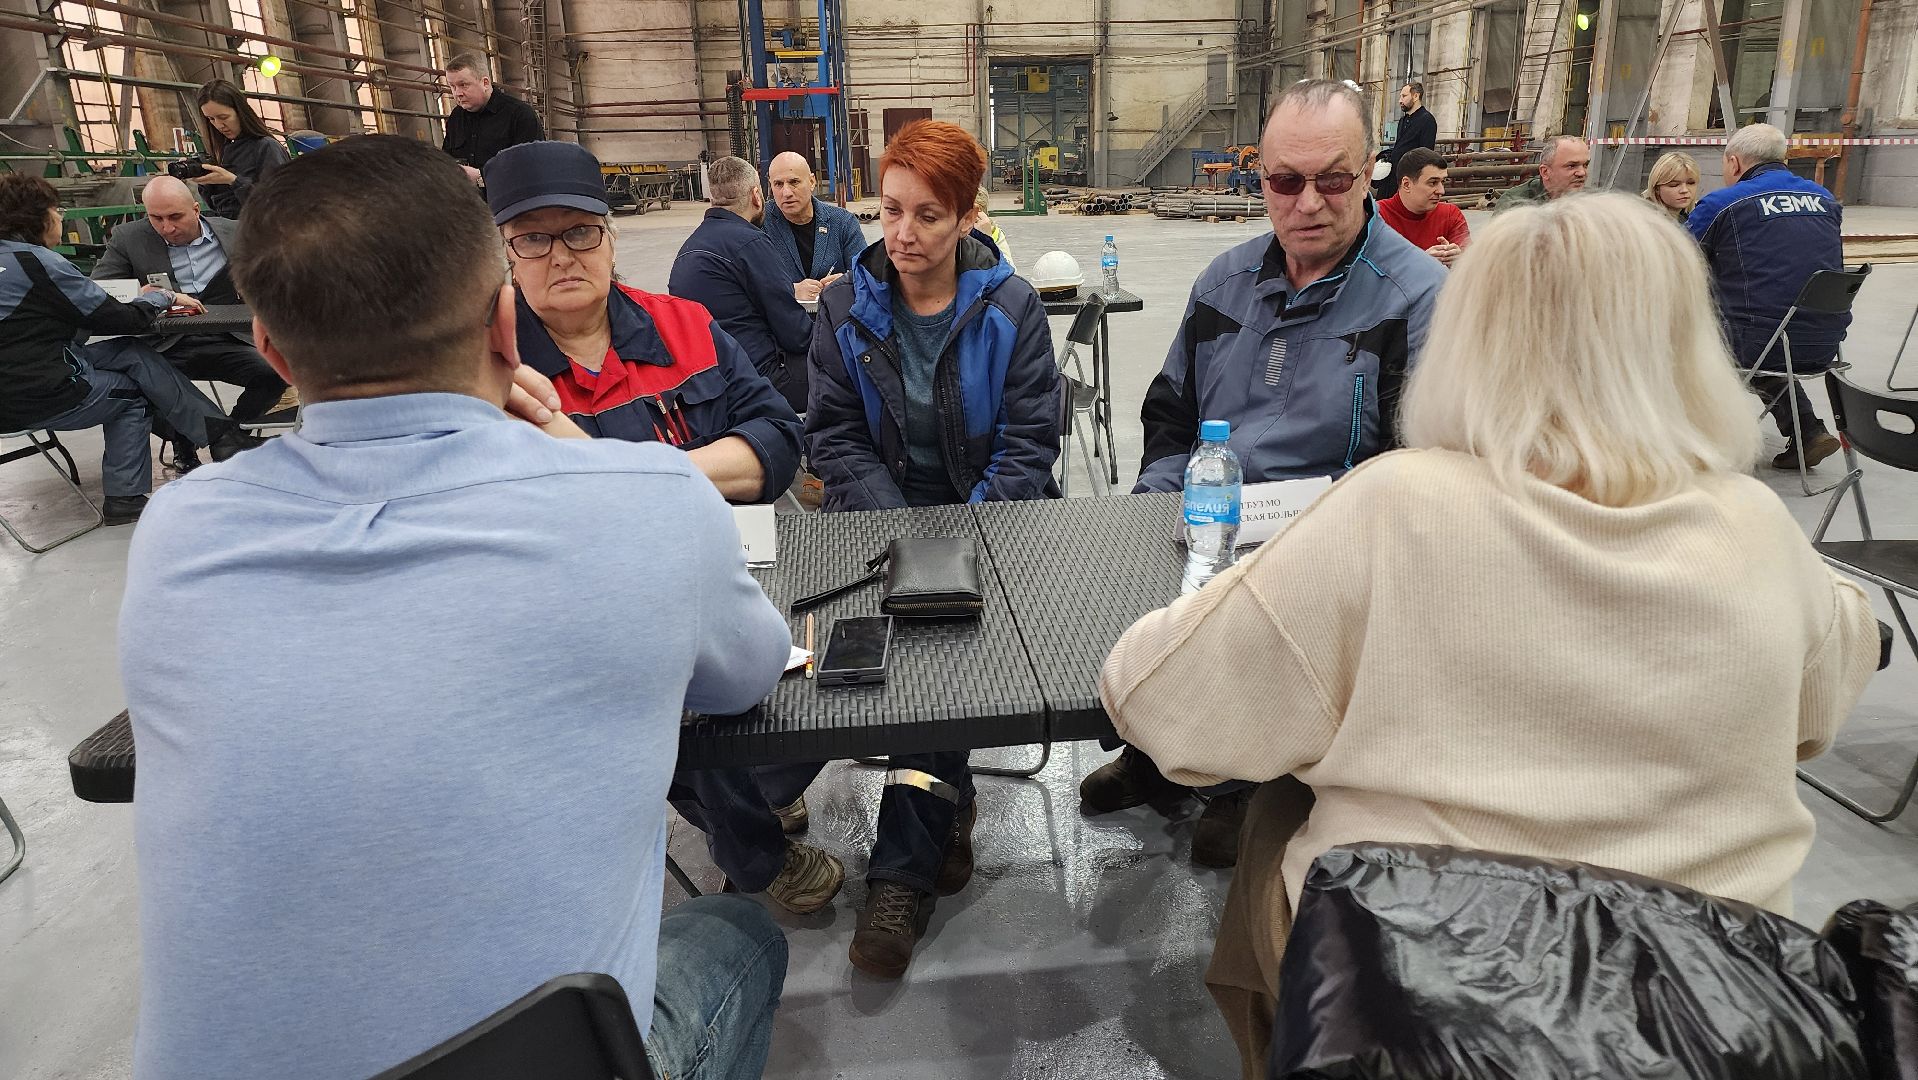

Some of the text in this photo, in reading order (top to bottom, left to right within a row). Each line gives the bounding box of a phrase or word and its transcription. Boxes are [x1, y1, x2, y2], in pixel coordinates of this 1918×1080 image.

[1760, 195, 1827, 216] КЗМК
[1184, 500, 1230, 516] апелия
[1240, 509, 1301, 522] СКАЯ БОЛЬН
